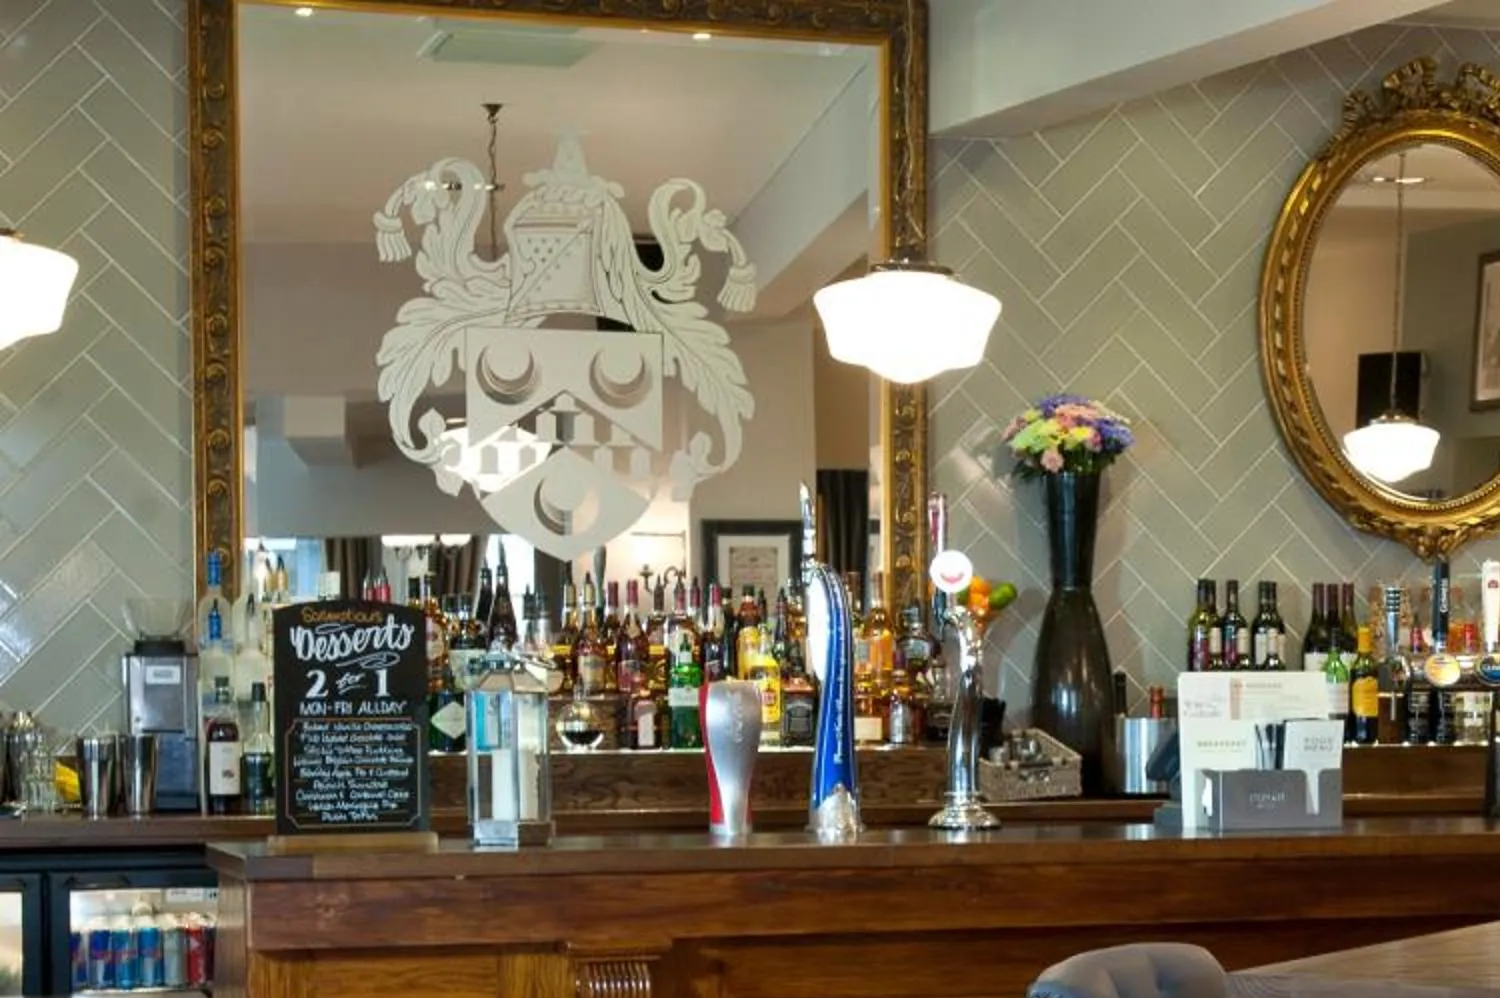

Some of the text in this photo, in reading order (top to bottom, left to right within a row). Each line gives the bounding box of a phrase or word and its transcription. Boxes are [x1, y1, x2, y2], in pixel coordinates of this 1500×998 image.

[290, 613, 416, 661] Desserts
[305, 669, 329, 698] 2
[376, 668, 391, 698] 1
